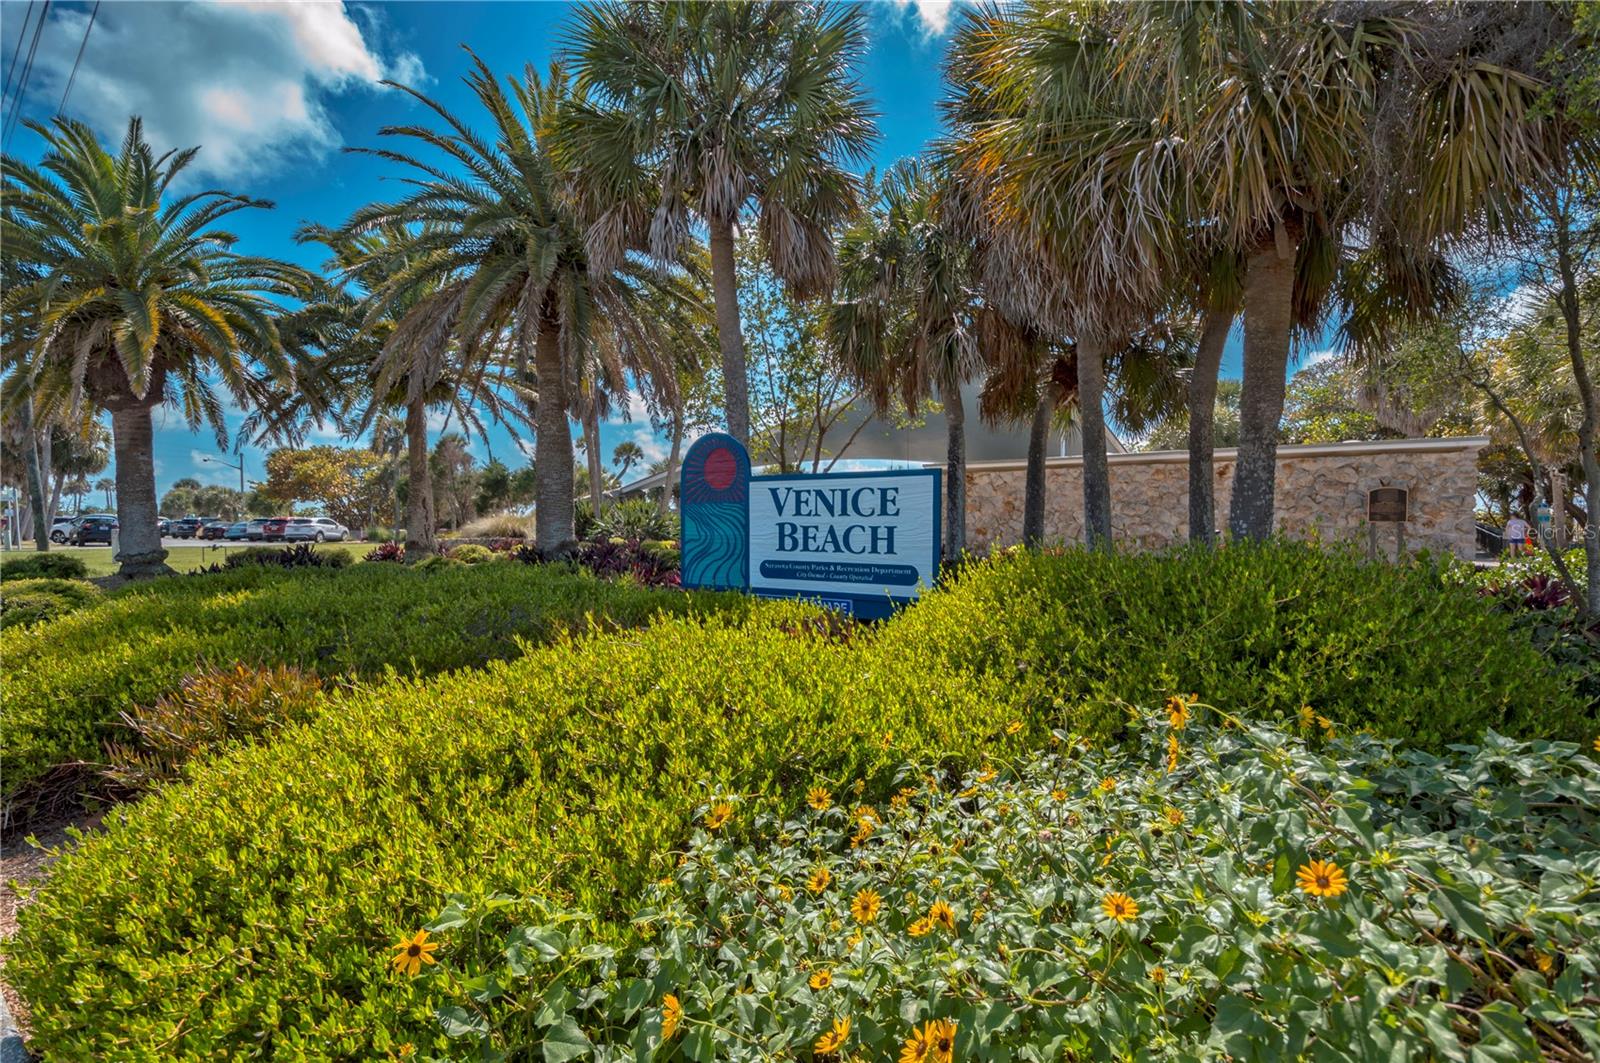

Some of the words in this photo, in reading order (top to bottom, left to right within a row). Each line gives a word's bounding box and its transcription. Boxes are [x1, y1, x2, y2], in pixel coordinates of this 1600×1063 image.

[768, 487, 900, 517] VENICE
[776, 522, 897, 555] BEACH
[830, 572, 847, 580] County
[849, 573, 873, 581] Operated
[871, 566, 912, 575] Department
